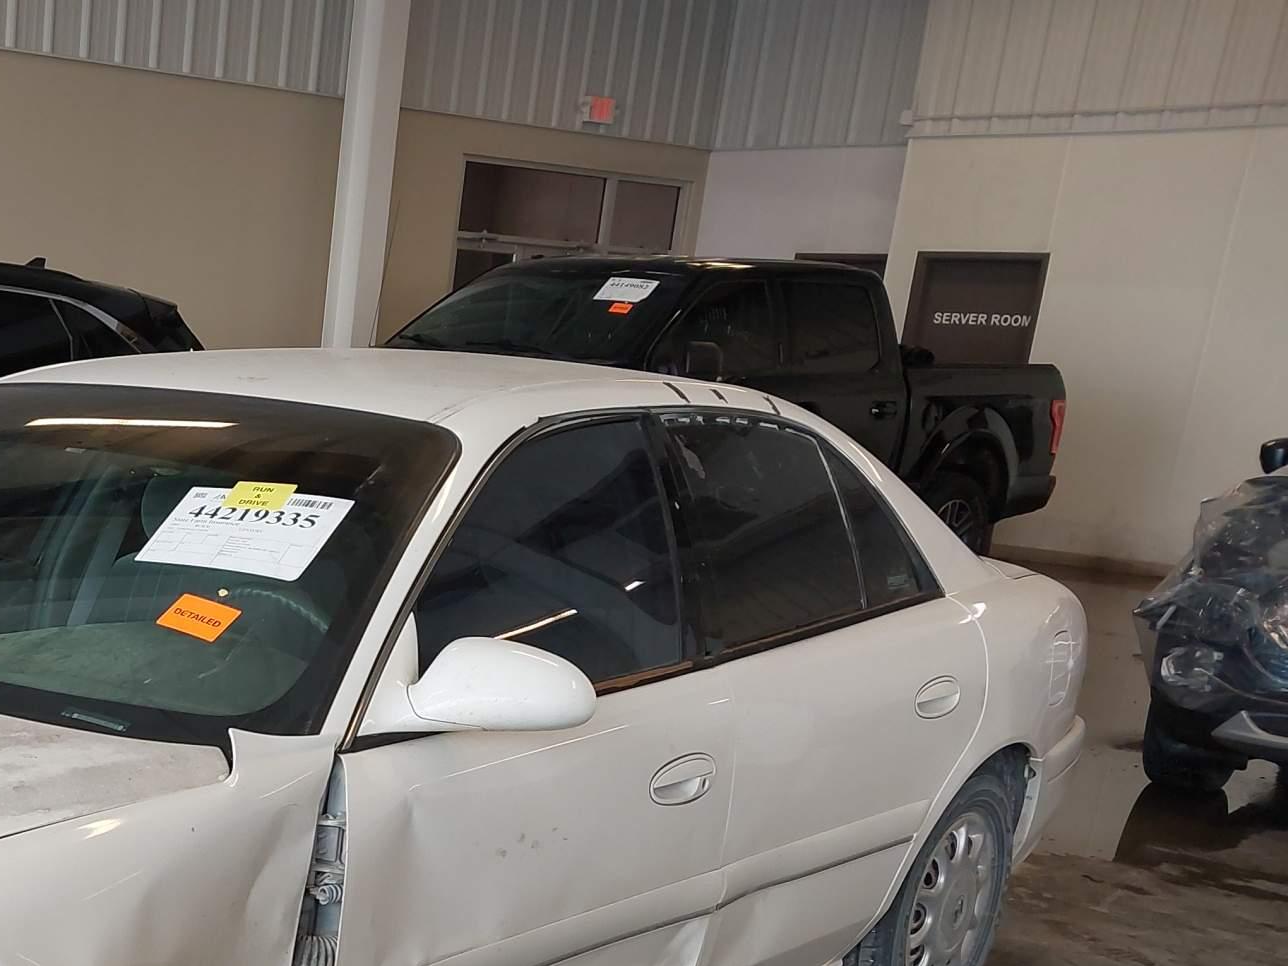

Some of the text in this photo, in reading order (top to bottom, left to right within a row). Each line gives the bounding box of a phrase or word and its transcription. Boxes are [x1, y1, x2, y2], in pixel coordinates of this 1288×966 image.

[933, 312, 987, 326] SERVER
[238, 499, 270, 507] DRIVE
[188, 504, 321, 529] 44219335
[174, 607, 222, 628] DETAILED
